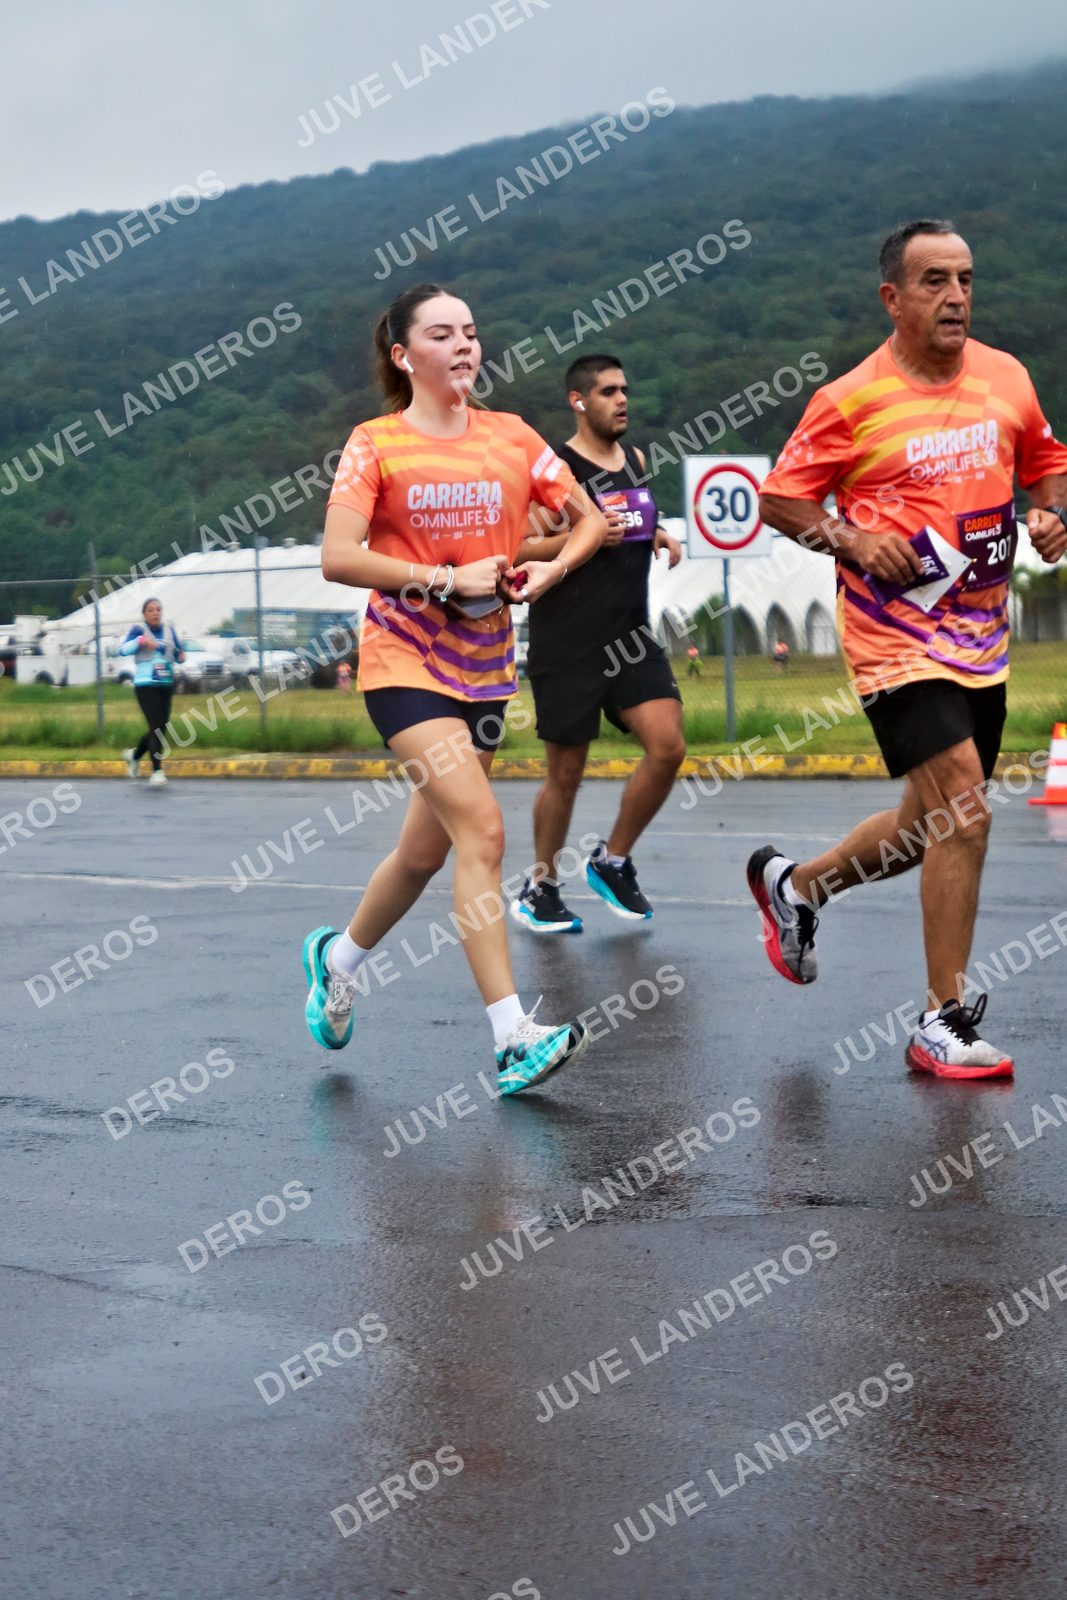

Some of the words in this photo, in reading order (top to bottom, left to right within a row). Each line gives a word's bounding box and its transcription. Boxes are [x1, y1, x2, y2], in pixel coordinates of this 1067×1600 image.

[907, 418, 998, 463] CARRERA
[407, 481, 502, 510] CARRERA
[706, 486, 751, 522] 30
[919, 554, 940, 575] 15K
